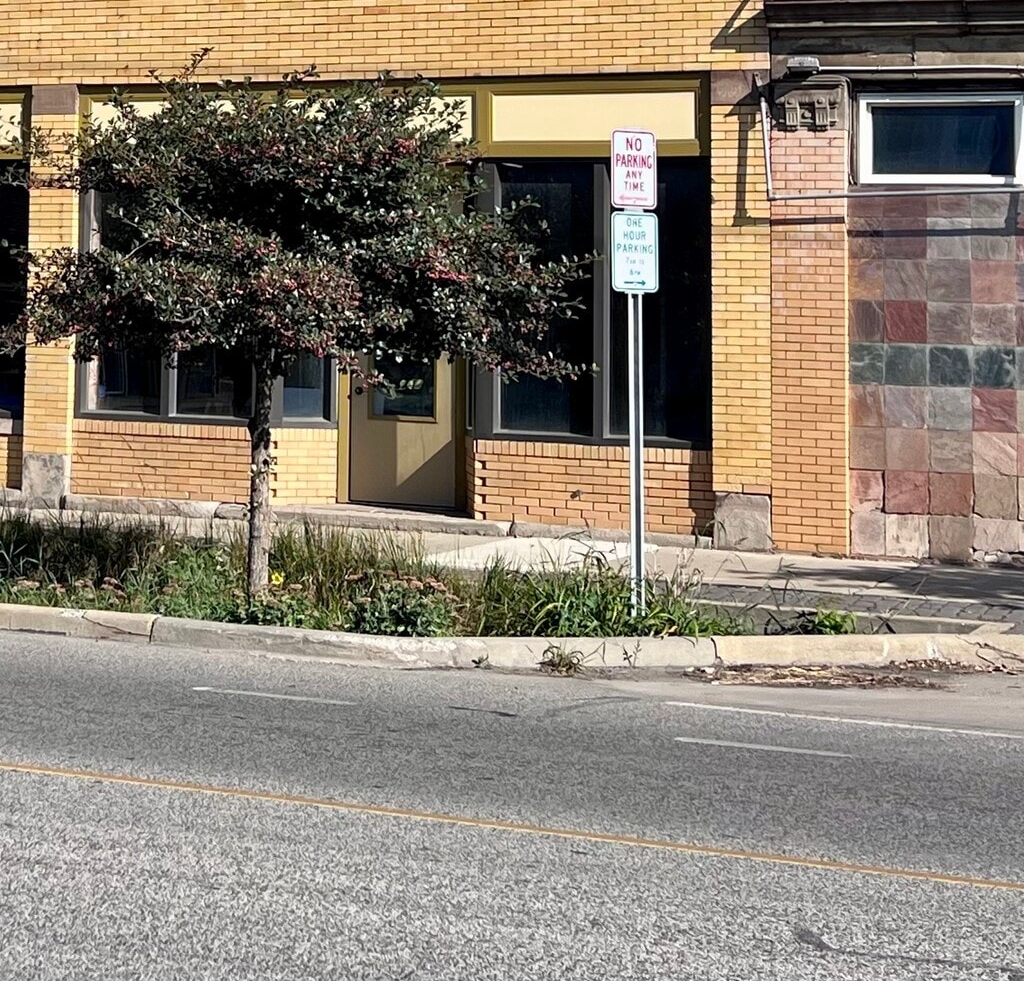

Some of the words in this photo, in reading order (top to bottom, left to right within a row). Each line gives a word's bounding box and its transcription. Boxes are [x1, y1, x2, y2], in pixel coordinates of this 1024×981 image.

[626, 137, 642, 151] NO
[616, 153, 652, 169] PARKING
[625, 170, 643, 180] ANY
[624, 181, 645, 192] TIME
[626, 217, 642, 227] ONE
[623, 231, 646, 241] HOUR
[616, 243, 653, 254] PARKING
